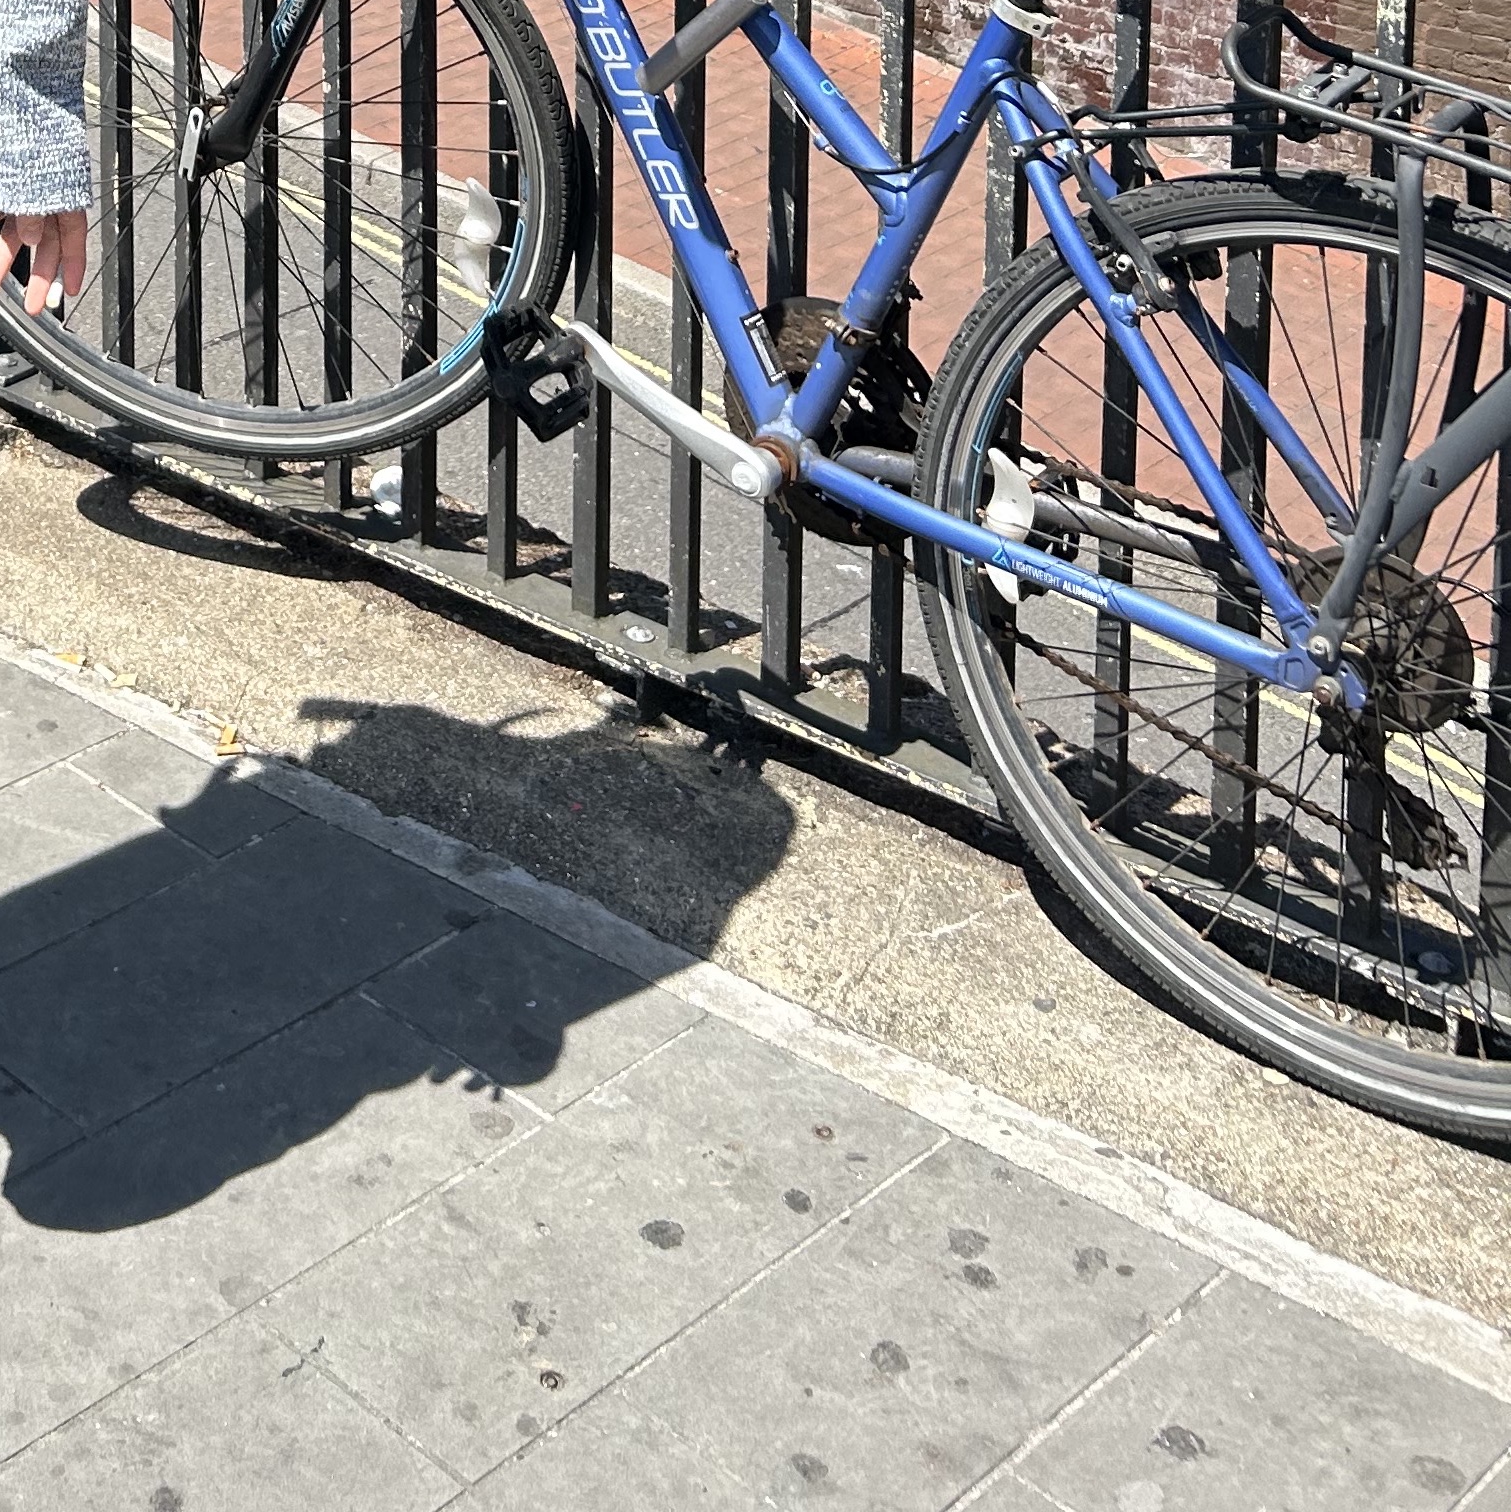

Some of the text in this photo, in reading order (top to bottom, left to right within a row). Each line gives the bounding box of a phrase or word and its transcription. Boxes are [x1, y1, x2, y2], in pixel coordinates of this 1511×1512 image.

[588, 26, 700, 231] BUTLER
[1011, 559, 1109, 609] LIGHTWEIGHT ALUMINIUM
